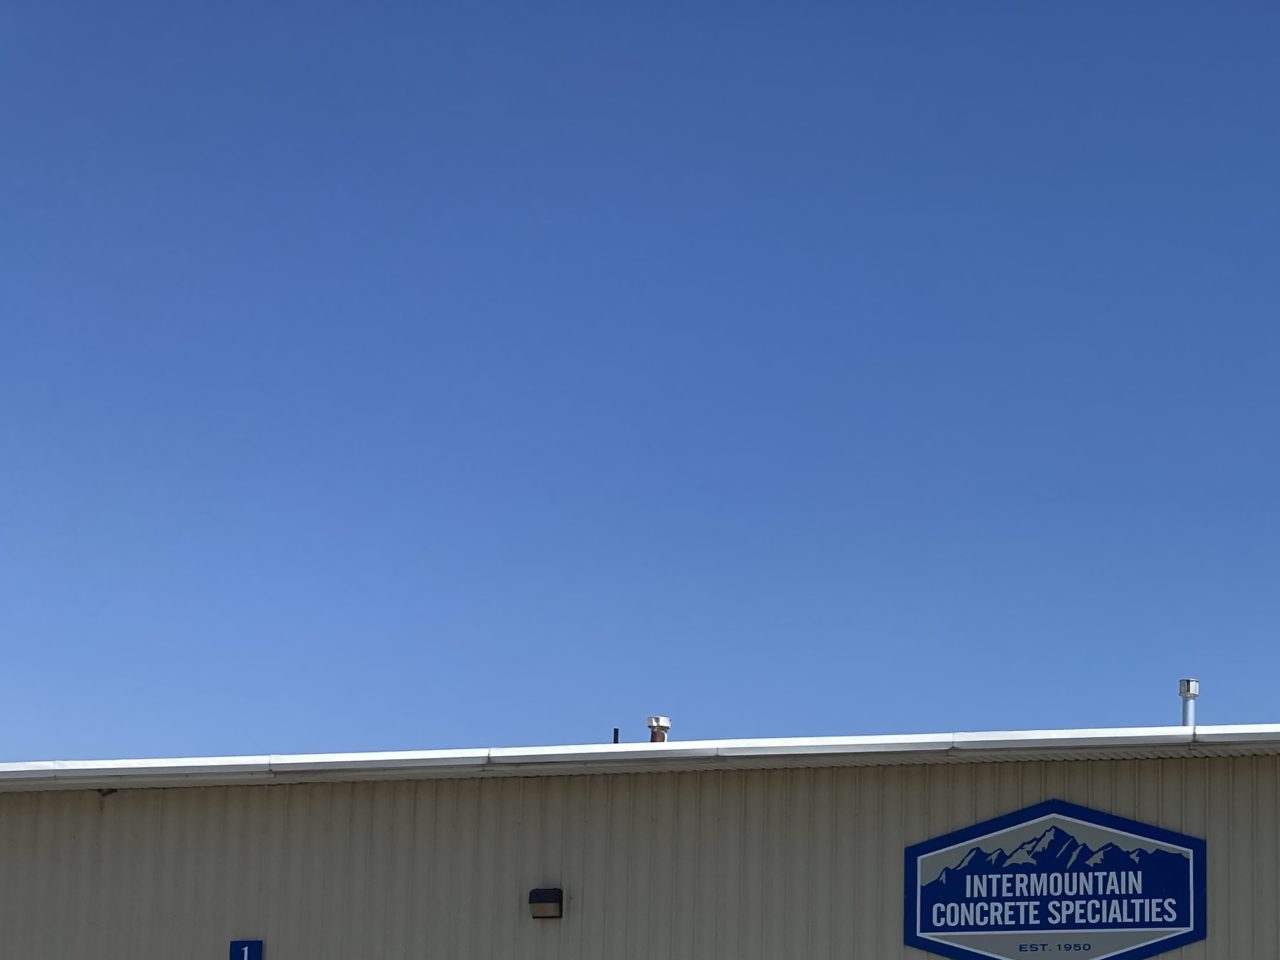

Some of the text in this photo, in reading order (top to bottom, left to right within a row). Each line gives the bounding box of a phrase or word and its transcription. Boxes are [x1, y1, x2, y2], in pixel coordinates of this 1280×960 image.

[965, 870, 1143, 898] INTERMOUNTAIN
[932, 898, 1178, 927] CONCRETE SPECIALTIES
[1018, 943, 1092, 952] EST. 1950
